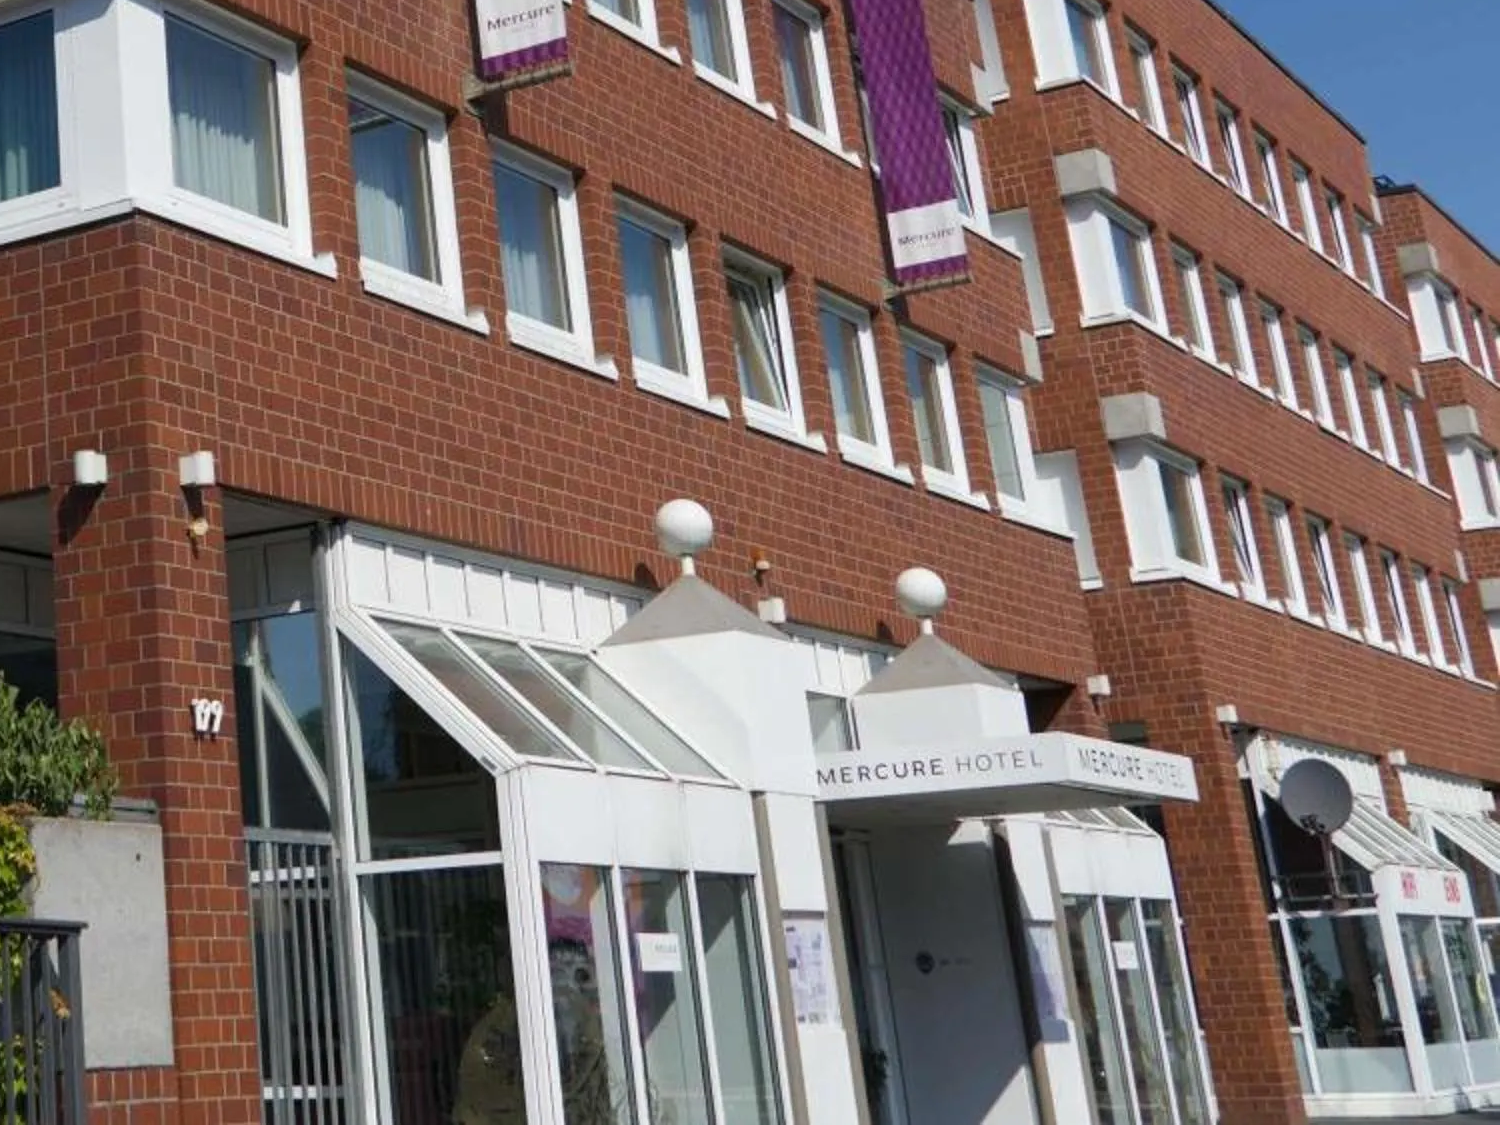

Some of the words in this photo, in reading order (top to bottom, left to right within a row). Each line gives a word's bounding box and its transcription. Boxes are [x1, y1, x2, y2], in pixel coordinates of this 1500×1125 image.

[487, 4, 556, 32] Mercure
[816, 758, 945, 786] MERCURE
[955, 750, 1044, 773] HOTEL
[1078, 747, 1144, 781] MERCURE
